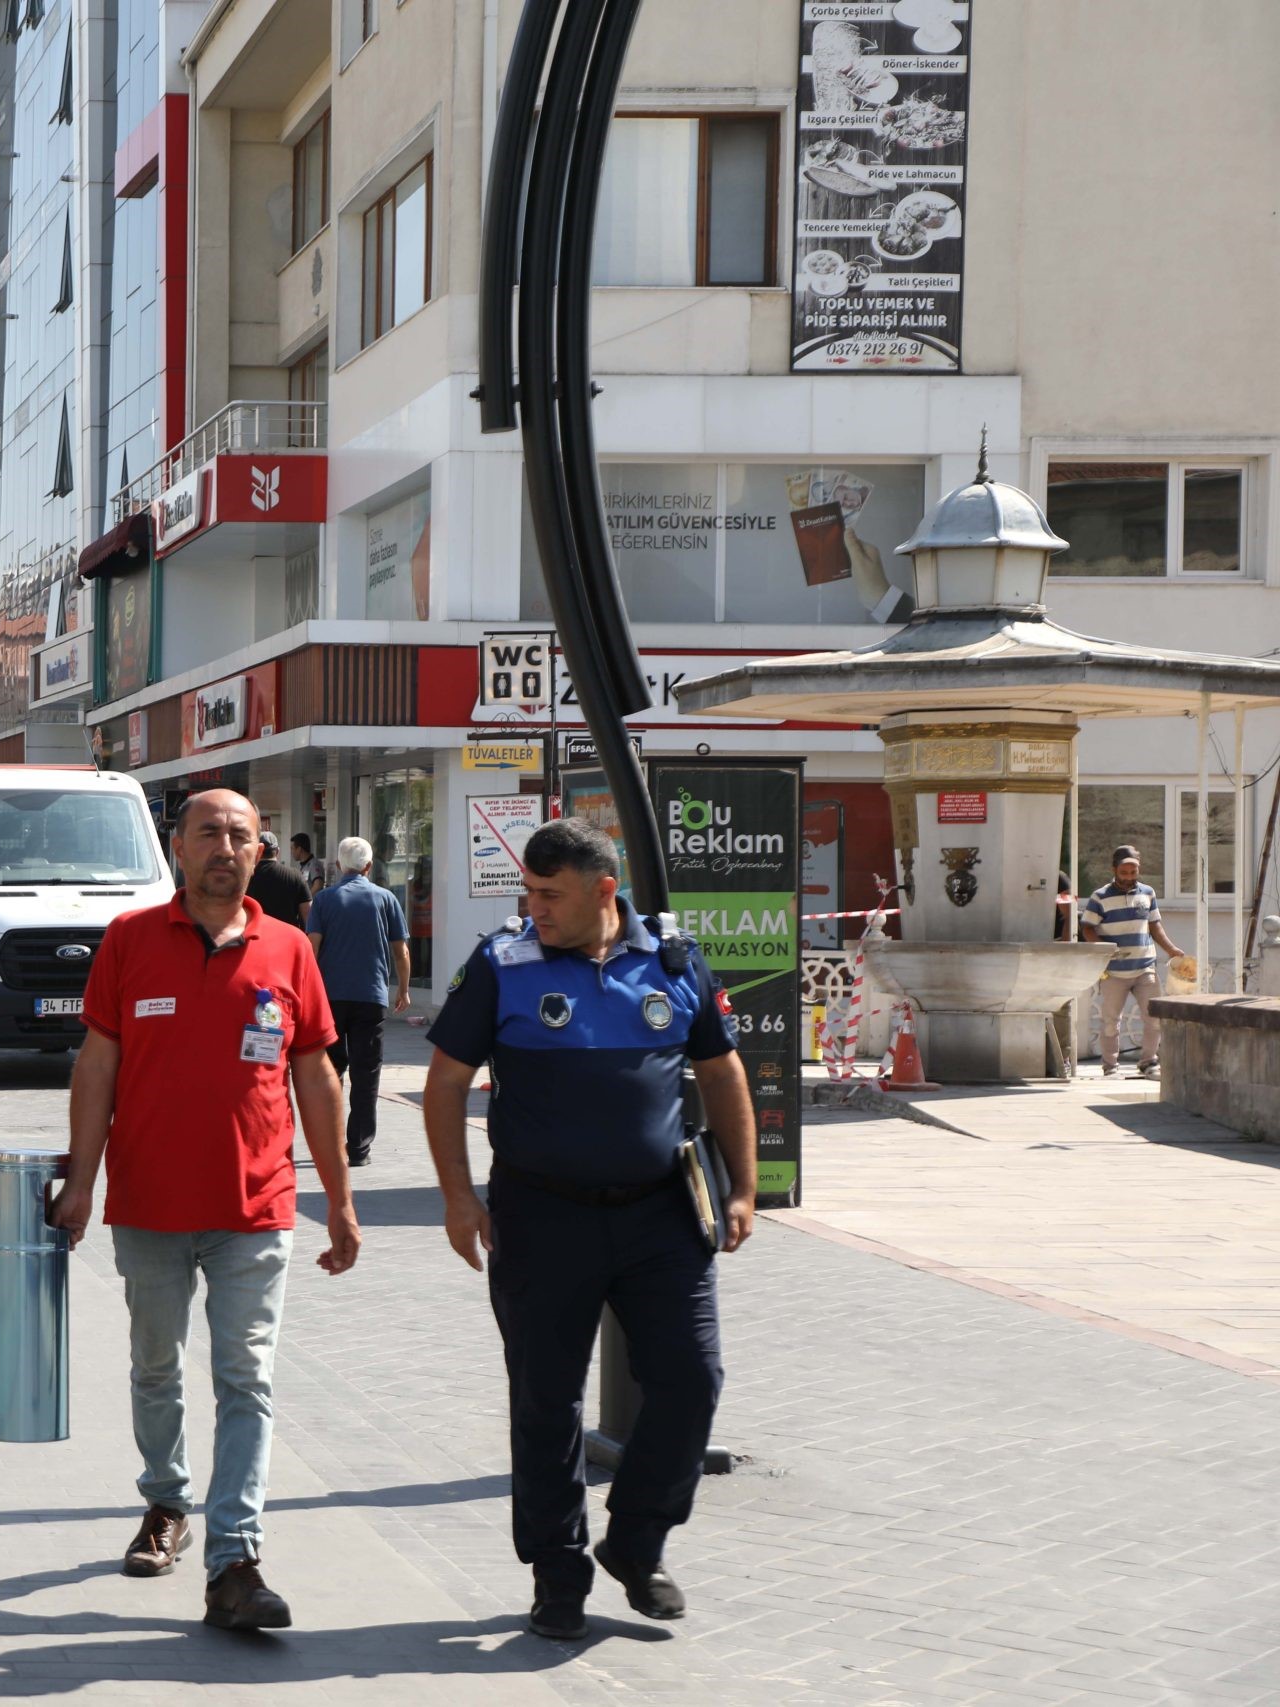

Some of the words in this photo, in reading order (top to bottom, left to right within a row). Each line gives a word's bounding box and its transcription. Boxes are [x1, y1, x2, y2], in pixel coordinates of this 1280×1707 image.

[811, 7, 840, 17] Çorba
[842, 5, 884, 17] Çeşitleri
[882, 57, 959, 69] Döner-İskender
[838, 115, 878, 126] Çeşitleri
[869, 170, 890, 179] Pide
[906, 170, 956, 179] Lahmacun
[804, 223, 840, 232] Tencere
[842, 223, 889, 232] Yemekleri
[888, 277, 910, 287] Tatlı
[912, 277, 953, 289] Çeşitleri
[819, 298, 863, 310] TOPLU
[867, 298, 913, 310] YEMEK
[914, 298, 935, 310] VE
[805, 311, 837, 327] PİDE
[840, 310, 897, 330] SİPARİŞİ
[901, 314, 947, 327] ALINIR
[826, 343, 860, 355] 0374
[862, 343, 886, 355] 212
[888, 343, 907, 355] 26
[909, 343, 925, 355] 91
[606, 514, 654, 529] ATILIM
[657, 512, 777, 530] GÜVENCESİYLE
[612, 532, 708, 549] EĞERLENSİN
[491, 645, 543, 666] WC
[570, 745, 598, 753] EFSAN
[668, 799, 732, 830] Bolu
[668, 827, 784, 854] Reklam
[480, 871, 520, 879] GARANTİLİ
[473, 880, 500, 888] TEKNİK
[699, 942, 789, 956] RVASYON
[43, 1000, 56, 1012] 34
[62, 1000, 82, 1012] FTF
[761, 1014, 786, 1033] 66
